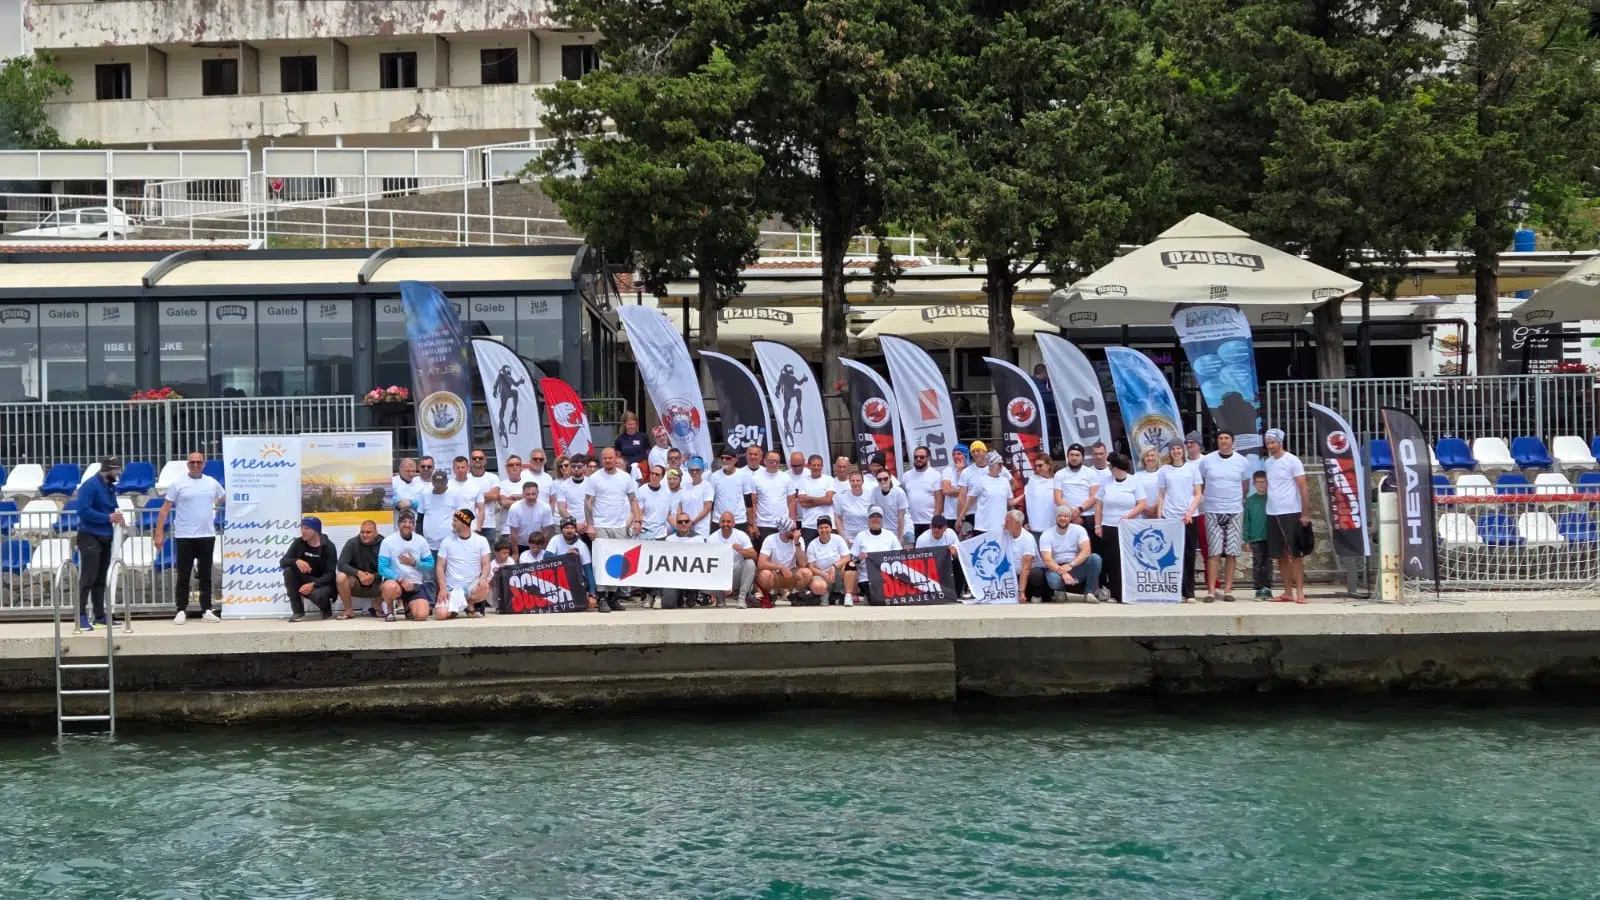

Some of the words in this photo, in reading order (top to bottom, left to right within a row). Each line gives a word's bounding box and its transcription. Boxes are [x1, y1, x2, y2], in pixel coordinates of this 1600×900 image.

[1168, 251, 1257, 268] Ožujsko
[48, 308, 79, 318] Galeb
[166, 306, 197, 317] Galeb
[266, 305, 298, 316] Galeb
[383, 304, 404, 314] Gal
[474, 302, 505, 313] Galeb
[230, 457, 296, 469] neum
[883, 554, 906, 562] DIVING
[907, 552, 933, 560] CENTER
[512, 566, 535, 575] DIVING
[536, 561, 562, 570] CENTER
[645, 554, 719, 575] JANAF
[1136, 571, 1179, 584] BLUE
[1137, 584, 1178, 593] OCEANS
[885, 592, 945, 605] SARAJEVO
